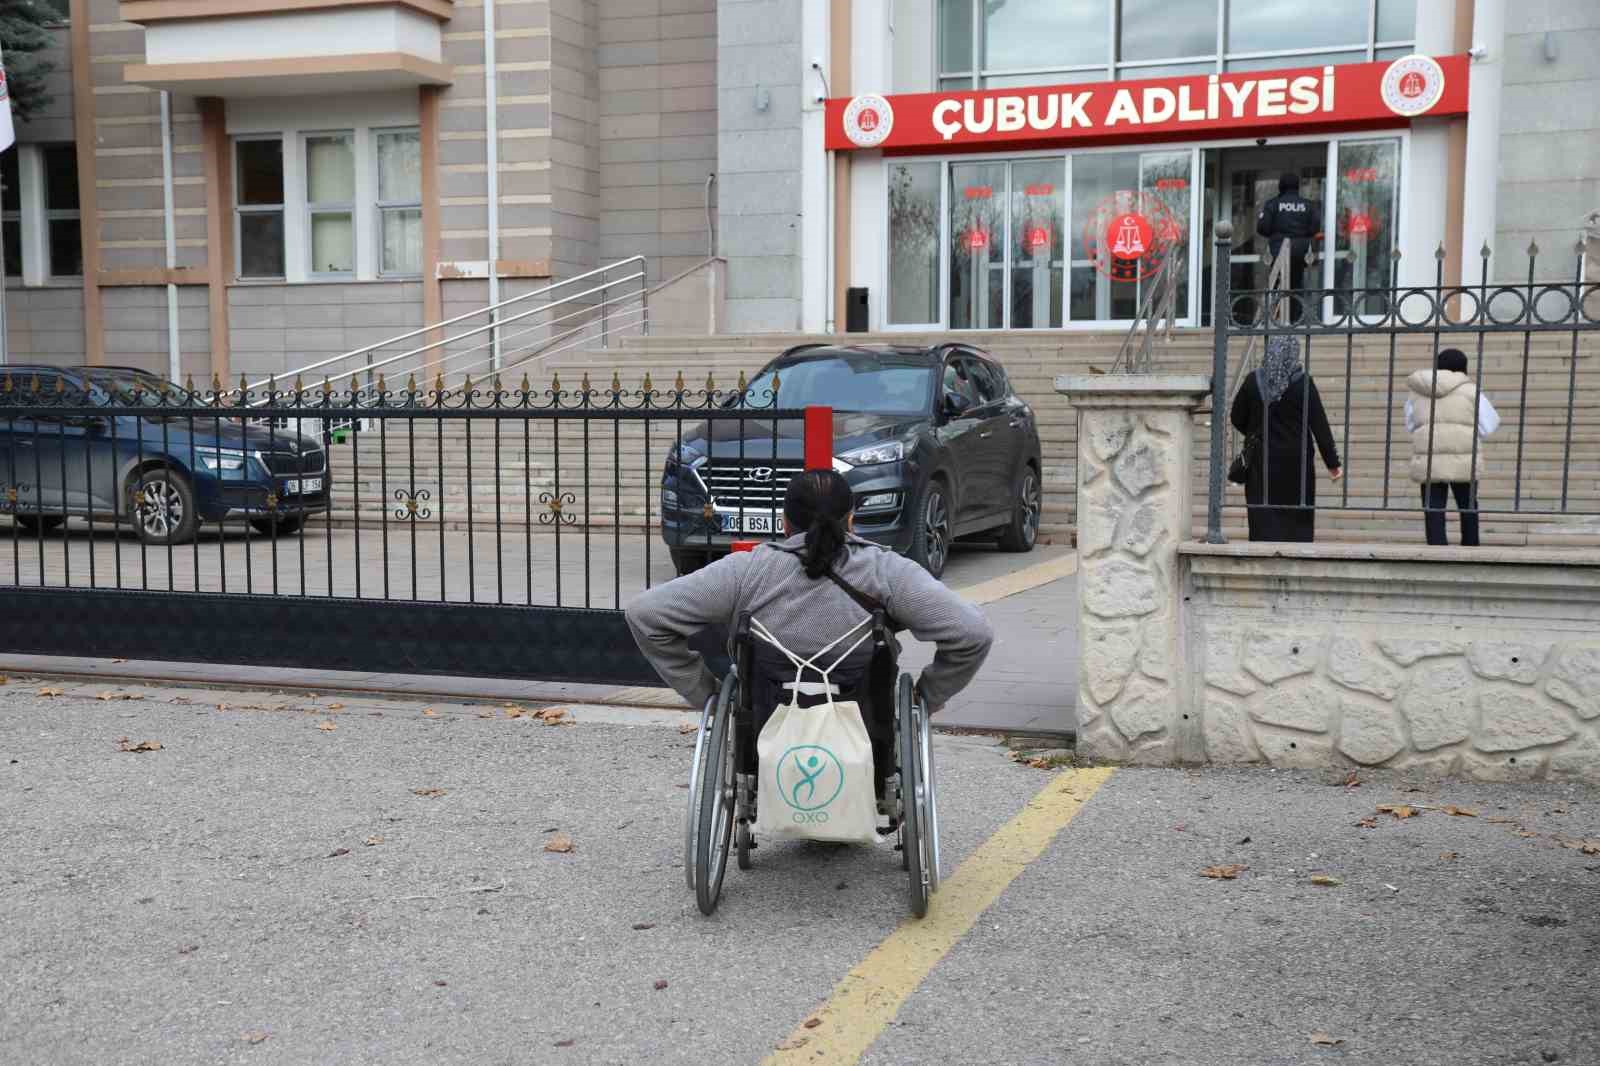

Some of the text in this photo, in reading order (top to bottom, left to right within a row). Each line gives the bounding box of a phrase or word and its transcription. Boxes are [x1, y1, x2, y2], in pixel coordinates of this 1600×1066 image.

[932, 65, 1334, 140] ÇUBUK ADLİYESİ
[749, 517, 769, 530] BSA
[792, 811, 829, 824] OXO
